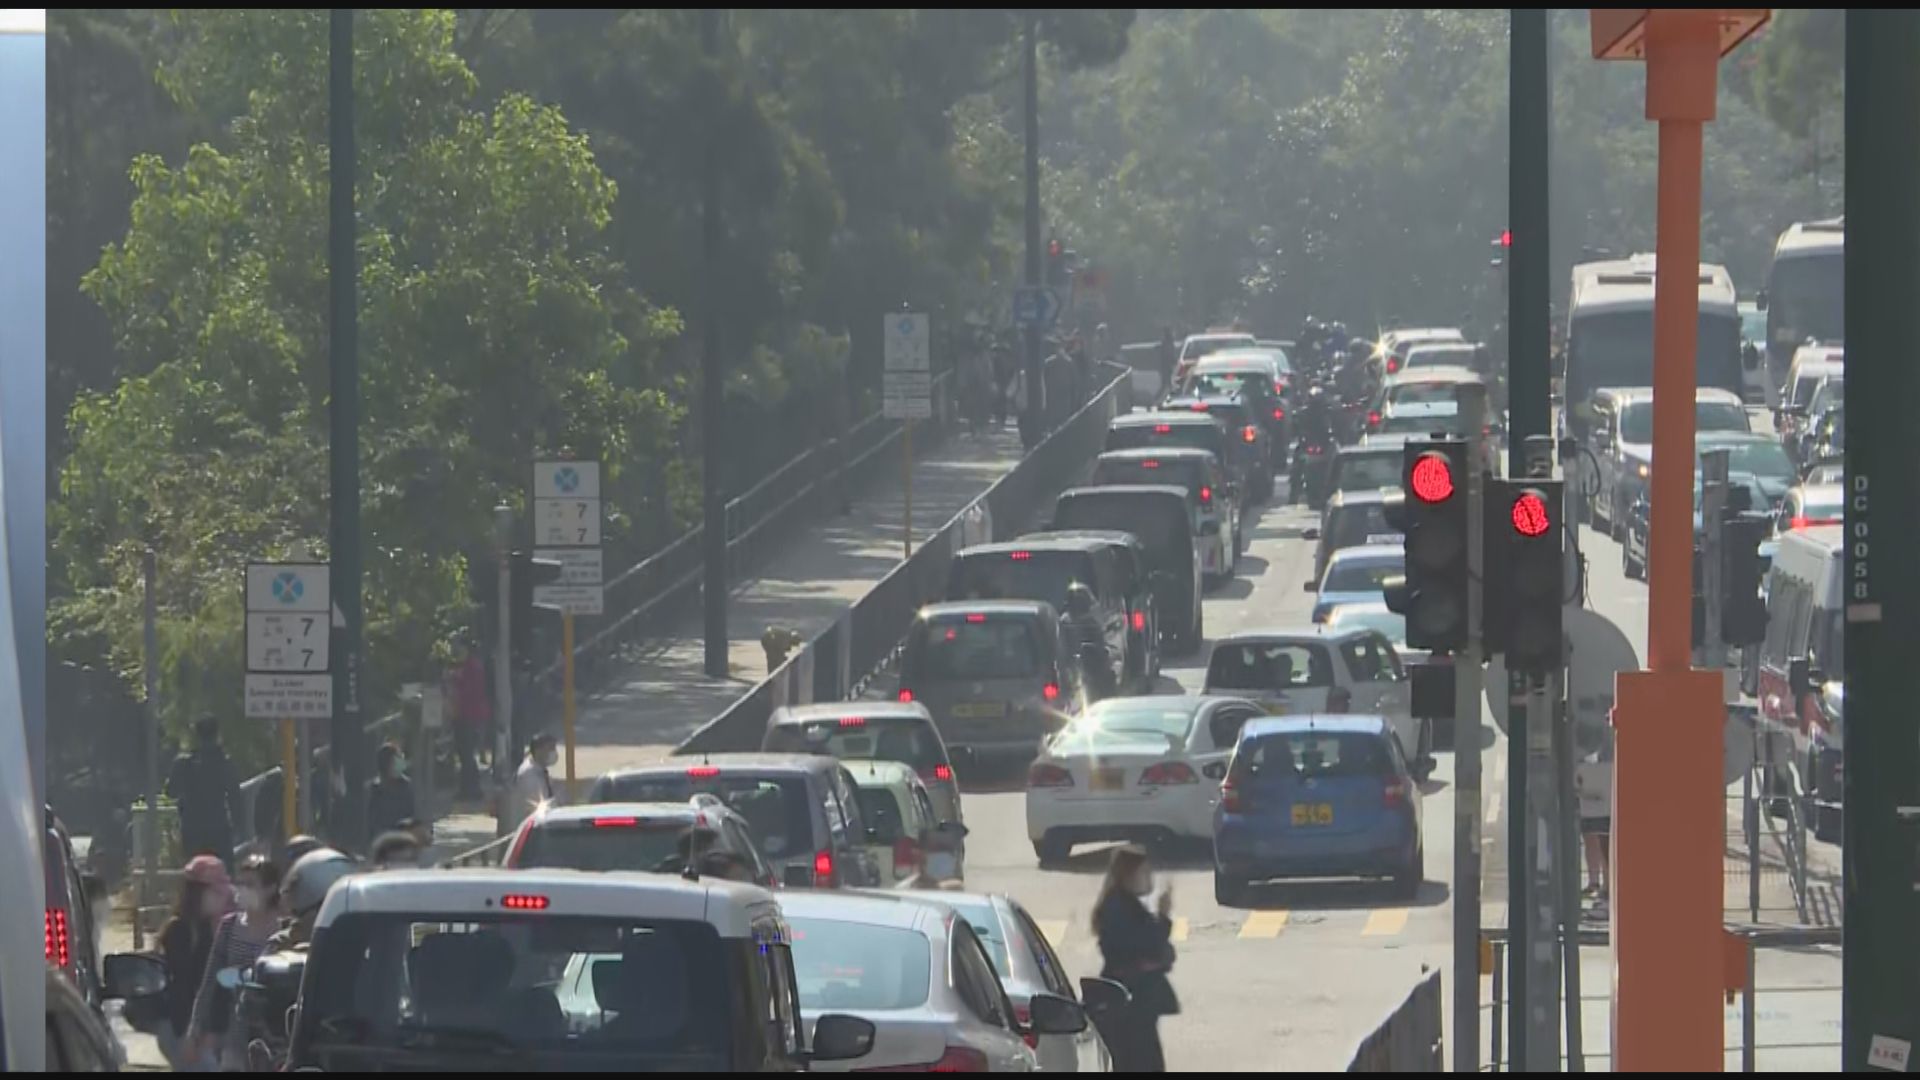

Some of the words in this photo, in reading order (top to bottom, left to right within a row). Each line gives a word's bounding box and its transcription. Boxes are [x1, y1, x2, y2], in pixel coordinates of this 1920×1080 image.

[1854, 475, 1869, 511] DC
[576, 502, 587, 519] 7
[577, 527, 588, 543] 7
[1854, 522, 1869, 599] 0058
[301, 617, 315, 637] 7
[301, 649, 314, 668] 7
